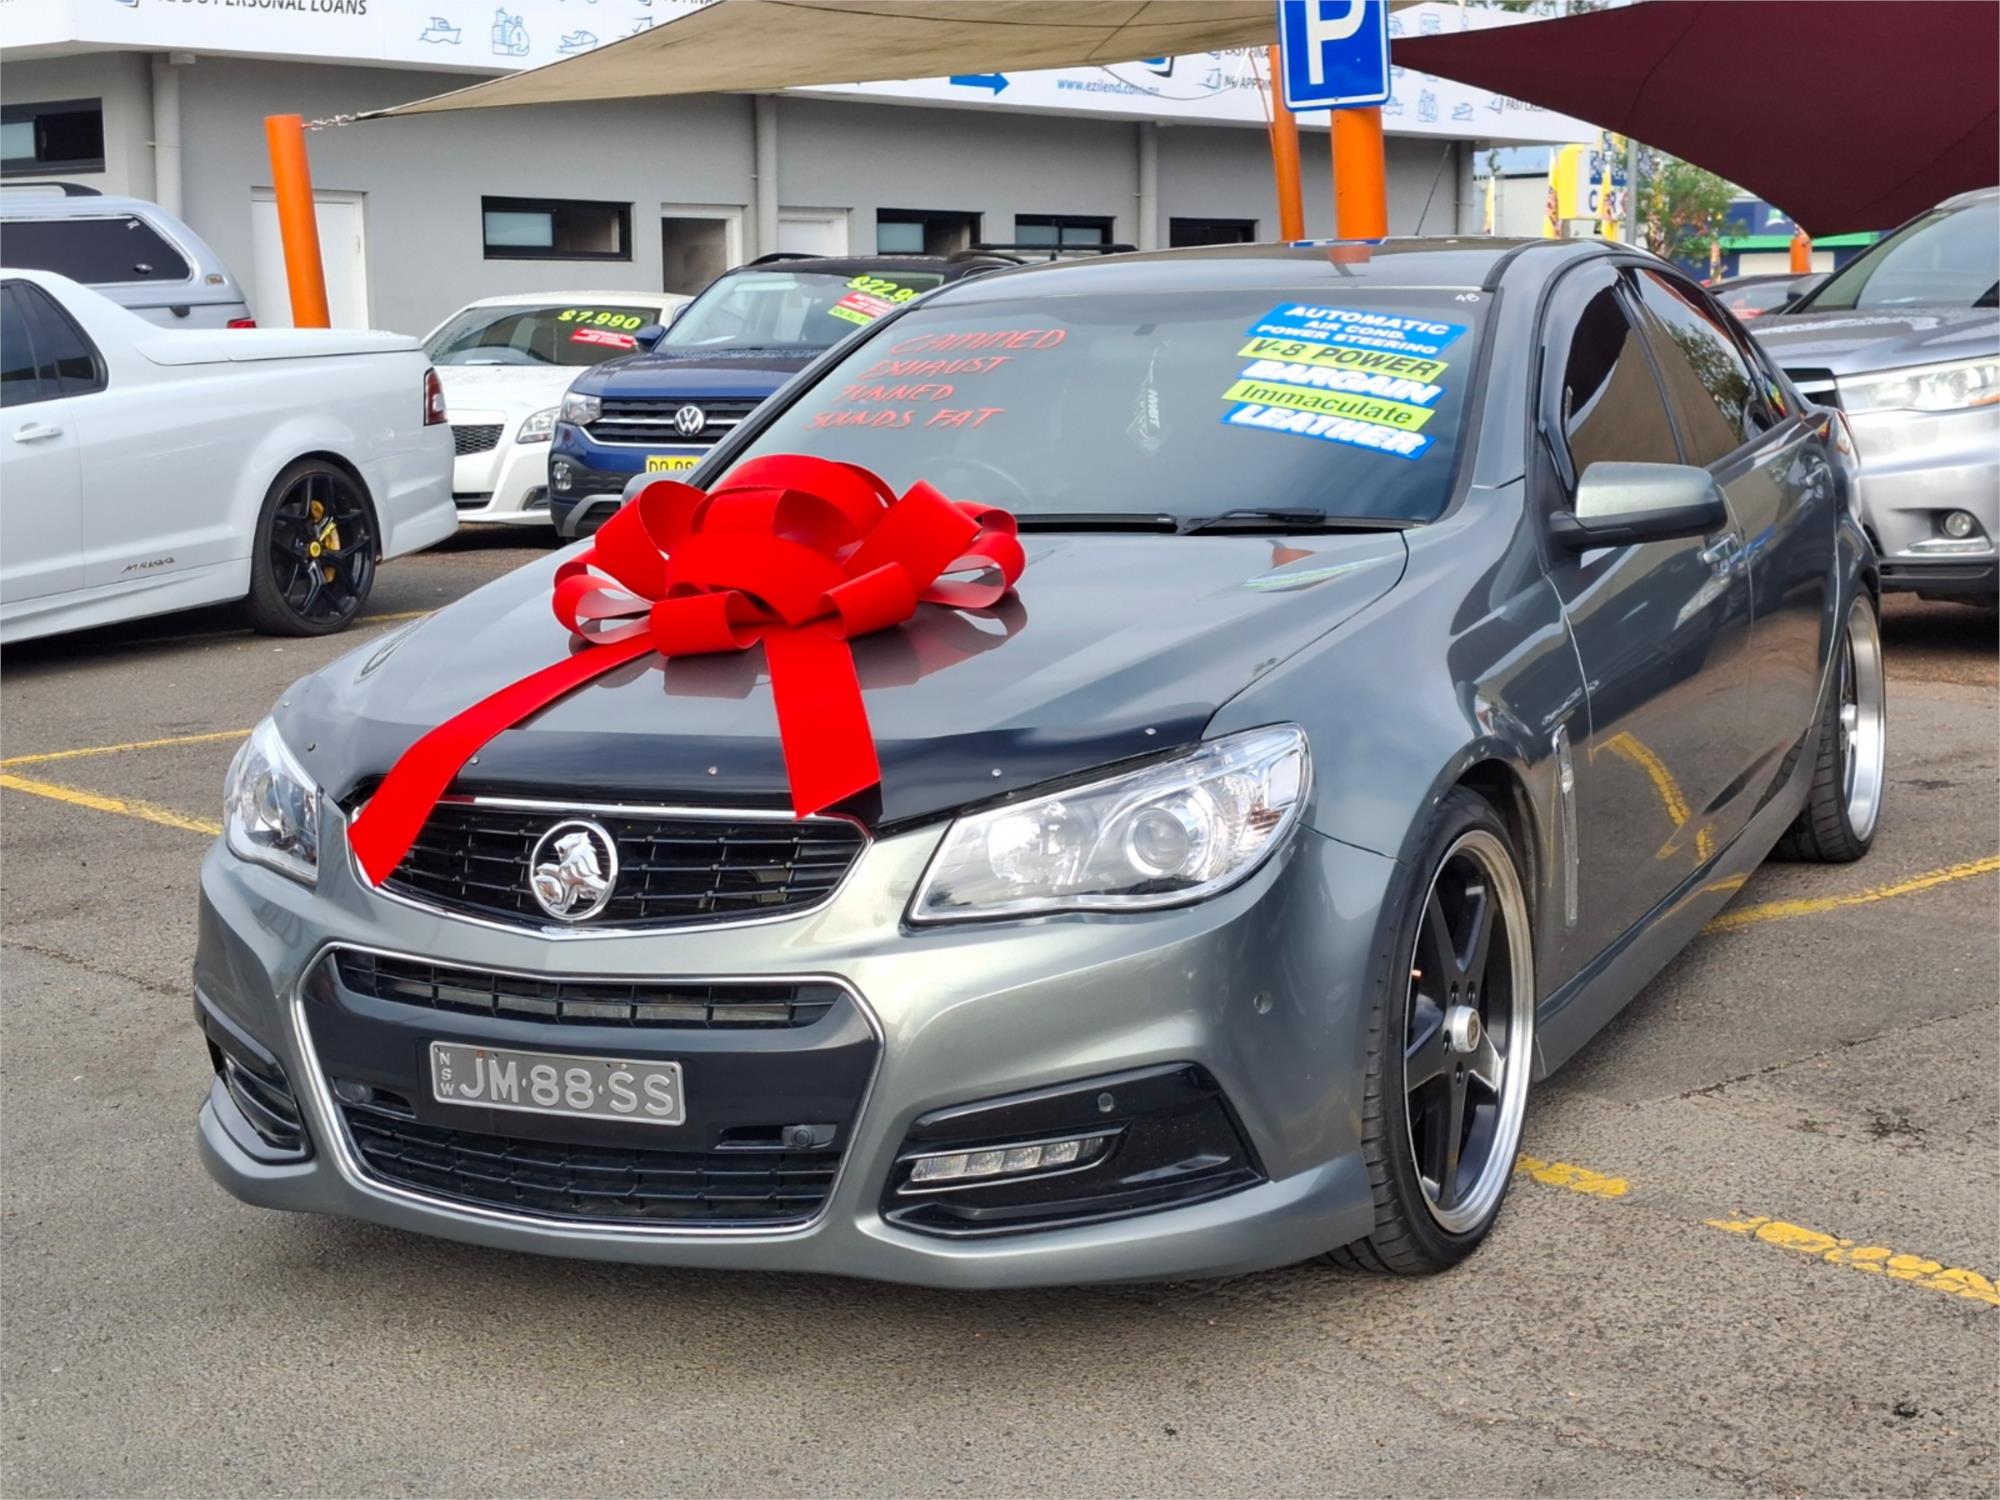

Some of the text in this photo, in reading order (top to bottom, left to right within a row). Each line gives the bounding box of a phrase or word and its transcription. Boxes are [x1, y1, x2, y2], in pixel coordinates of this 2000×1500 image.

[214, 0, 367, 15] RSONAL LOANS
[1304, 0, 1365, 85] P
[1284, 306, 1450, 335] AUTOMATIC
[1303, 320, 1407, 341] AIR COND.
[1257, 324, 1438, 355] POWER STEERING
[857, 356, 1017, 381] EXHAUST
[1252, 339, 1440, 377] V-8 POWER
[1242, 359, 1441, 404] BARGAIN
[803, 406, 1008, 431] SOUNDS FAT
[1240, 384, 1413, 424] Immaculate
[1230, 404, 1427, 454] LEATHER
[438, 1053, 455, 1096] NSW
